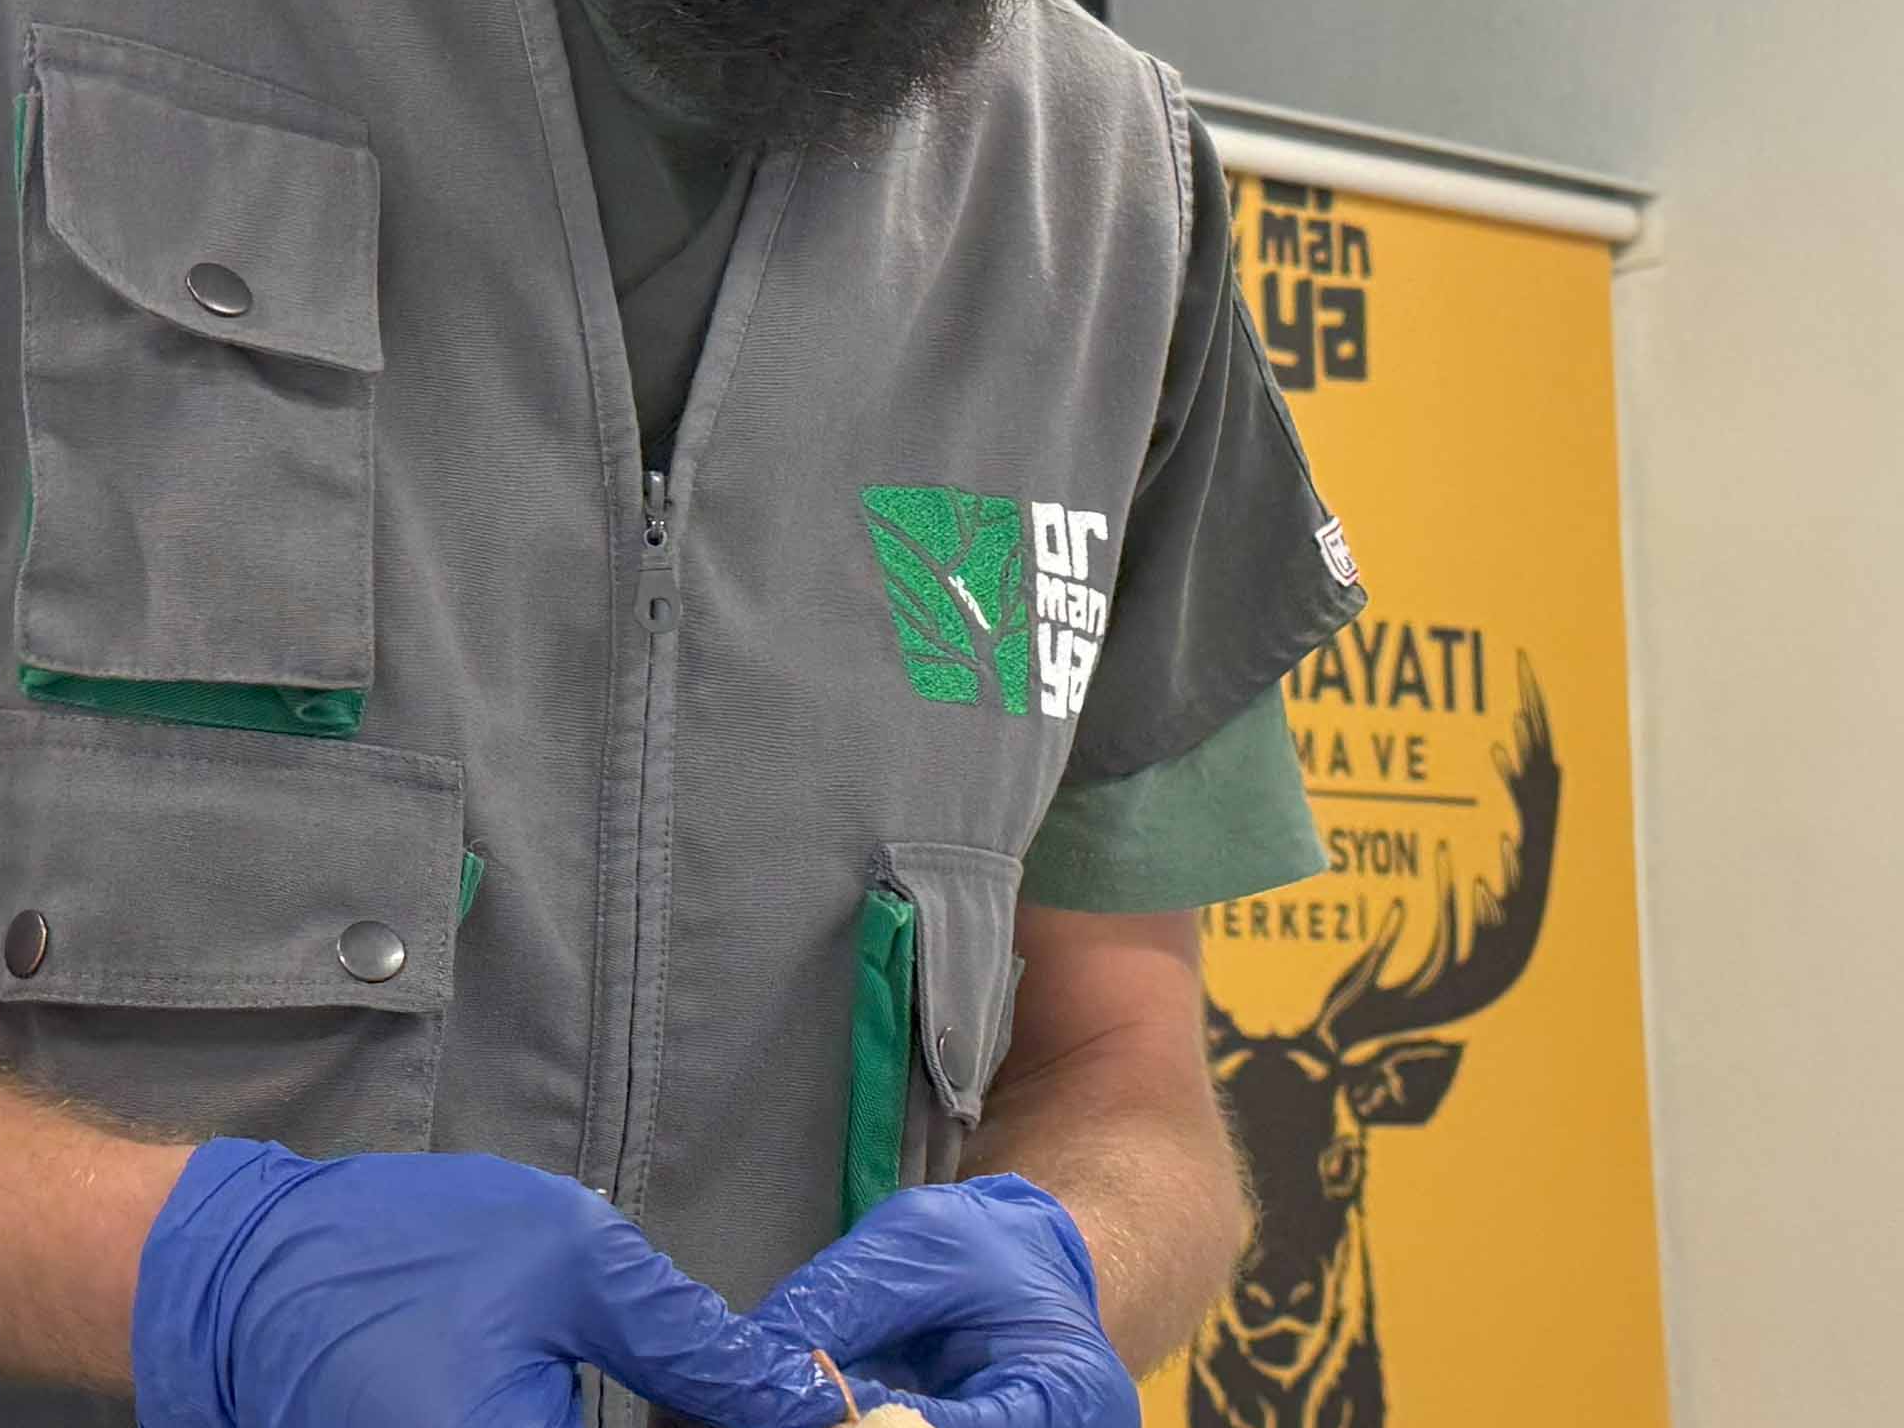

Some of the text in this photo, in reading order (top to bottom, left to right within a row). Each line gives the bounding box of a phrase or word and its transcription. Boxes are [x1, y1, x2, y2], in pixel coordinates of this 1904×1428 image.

[1260, 209, 1372, 280] man
[1263, 271, 1367, 390] ya
[1036, 572, 1107, 637] man
[1370, 732, 1428, 780] VE
